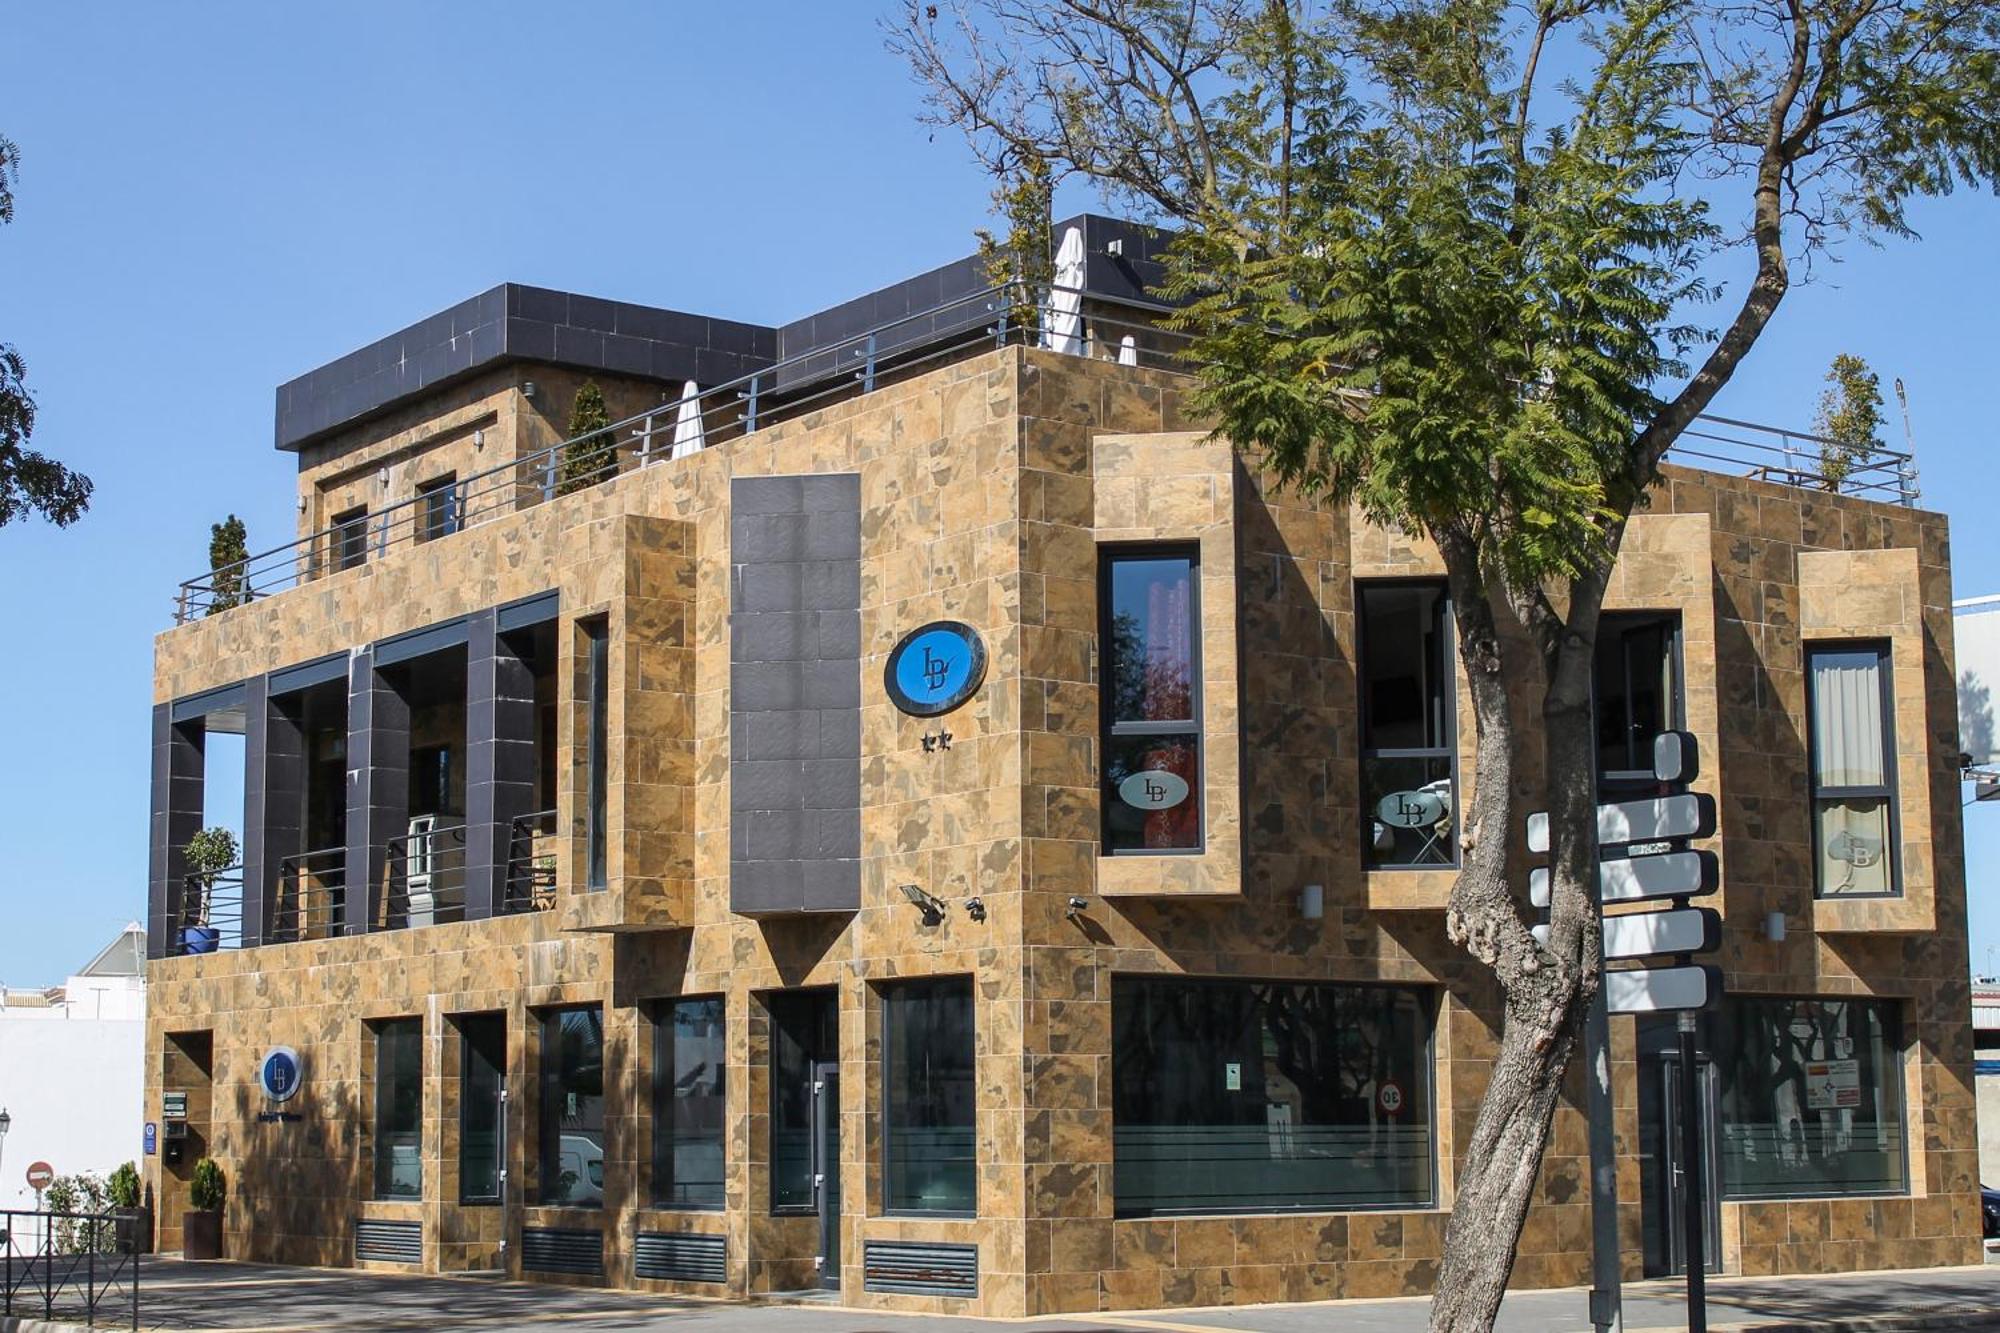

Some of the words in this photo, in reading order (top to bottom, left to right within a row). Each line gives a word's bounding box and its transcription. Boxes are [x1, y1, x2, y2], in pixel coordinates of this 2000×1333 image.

[922, 647, 953, 690] LB
[1144, 778, 1168, 802] LB
[1395, 794, 1427, 825] LB
[273, 1058, 285, 1091] LB
